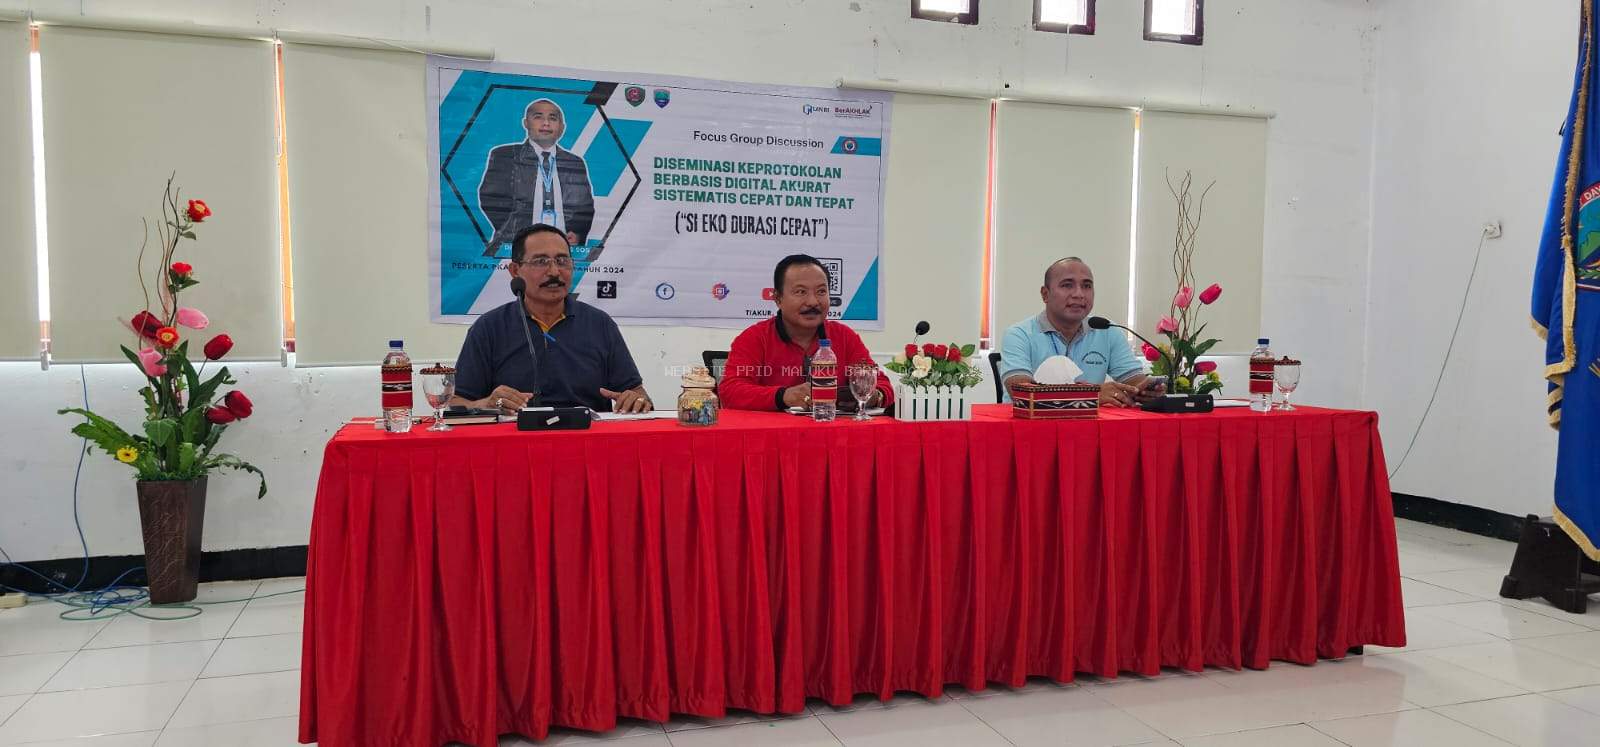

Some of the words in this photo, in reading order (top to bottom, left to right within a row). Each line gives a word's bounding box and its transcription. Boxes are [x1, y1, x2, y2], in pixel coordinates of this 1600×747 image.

[693, 131, 727, 143] Focus
[730, 133, 763, 146] Group
[766, 136, 824, 149] Discussion
[653, 156, 735, 174] DISEMINASI
[737, 161, 842, 179] KEPROTOKOLAN
[653, 172, 722, 188] BERBASIS
[725, 176, 777, 191] DIGITAL
[779, 179, 831, 194] AKURAT
[653, 188, 737, 204] SISTEMATIS
[739, 193, 782, 206] CEPAT
[785, 195, 812, 208] DAN
[814, 196, 855, 210] TEPAT
[702, 213, 727, 234] EKO
[730, 214, 777, 236] DURASI
[603, 266, 624, 274] 2024
